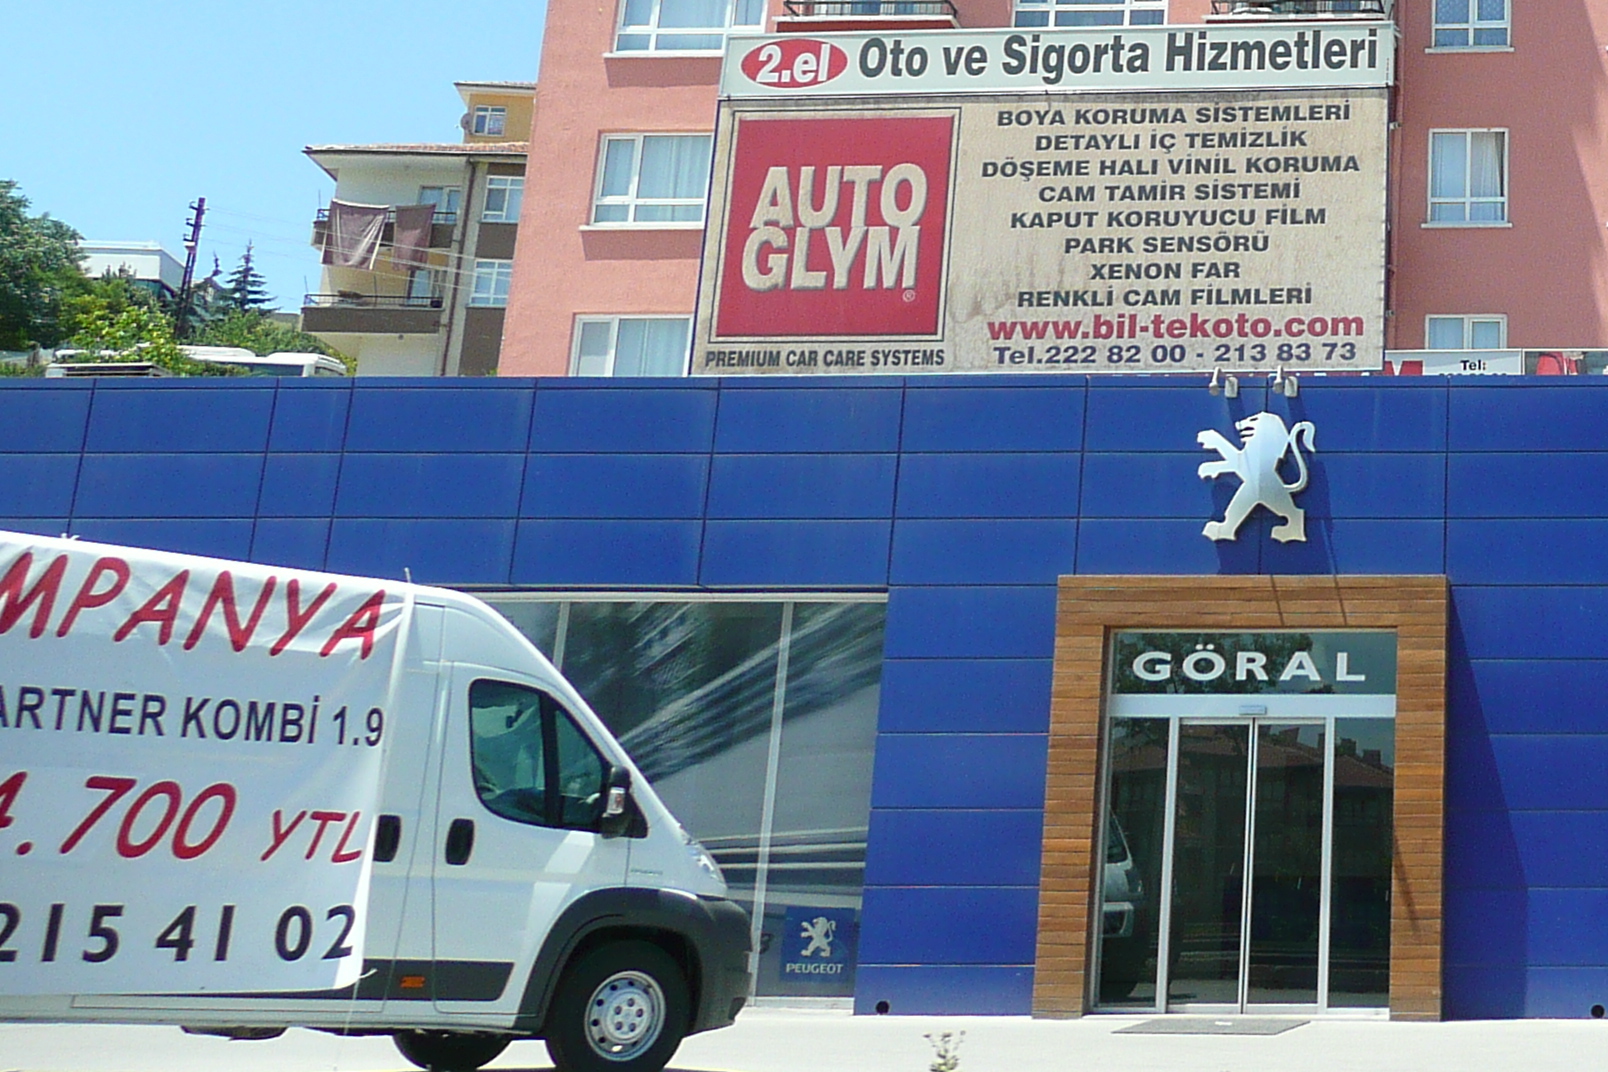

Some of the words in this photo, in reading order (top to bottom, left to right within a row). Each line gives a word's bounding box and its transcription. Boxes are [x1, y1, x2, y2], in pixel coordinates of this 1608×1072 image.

[754, 43, 832, 84] 2.el
[859, 37, 929, 78] Oto
[942, 44, 988, 76] ve
[1002, 33, 1151, 85] Sigorta
[1164, 28, 1378, 73] Hizmetleri
[997, 109, 1067, 127] BOYA
[1074, 107, 1188, 126] KORUMA
[1195, 99, 1351, 123] SİSTEMLERİ
[1035, 133, 1141, 152] DETAYLI
[1149, 131, 1176, 155] İÇ
[1184, 126, 1308, 150] TEMİZLİK
[981, 155, 1091, 182] DÖŞEME
[1099, 159, 1159, 177] HALI
[1167, 152, 1237, 175] VİNİL
[1244, 155, 1361, 174] KORUMA
[749, 162, 928, 228] AUTO
[1038, 185, 1096, 203] CAM
[1103, 180, 1186, 202] TAMİR
[1194, 177, 1301, 201] SİSTEMİ
[1009, 212, 1100, 229] KAPUT
[1106, 209, 1257, 228] KORUYUCU
[1265, 203, 1327, 225] FİLM
[1064, 236, 1135, 254] PARK
[1142, 230, 1270, 253] SENSÖRÜ
[741, 226, 921, 291] GLYM
[1089, 262, 1182, 281] XENON
[1191, 261, 1241, 279] FAR
[1017, 285, 1114, 308] RENKLİ
[1123, 289, 1182, 307] CAM
[1190, 282, 1313, 306] FİLMLERİ
[987, 312, 1365, 341] www.bil-tekoto.com
[705, 350, 781, 368] PREMIUM
[785, 350, 818, 368] CAR
[823, 349, 866, 367] CARE
[870, 348, 945, 367] SYSTEMS
[993, 344, 1097, 365] Tel.222
[1106, 344, 1142, 364] 82
[1151, 343, 1187, 363] 00
[1214, 343, 1267, 363] 213
[1276, 342, 1312, 362] 83
[1321, 342, 1357, 361] 73
[1460, 359, 1487, 372] Tel:
[1131, 643, 1366, 682] GÖRAL
[181, 695, 321, 744] KOMBİ
[333, 705, 384, 747] 1.9
[260, 809, 364, 863] YTL
[155, 904, 237, 962] 41
[274, 904, 357, 962] 02
[785, 962, 844, 975] PEUGEOT
